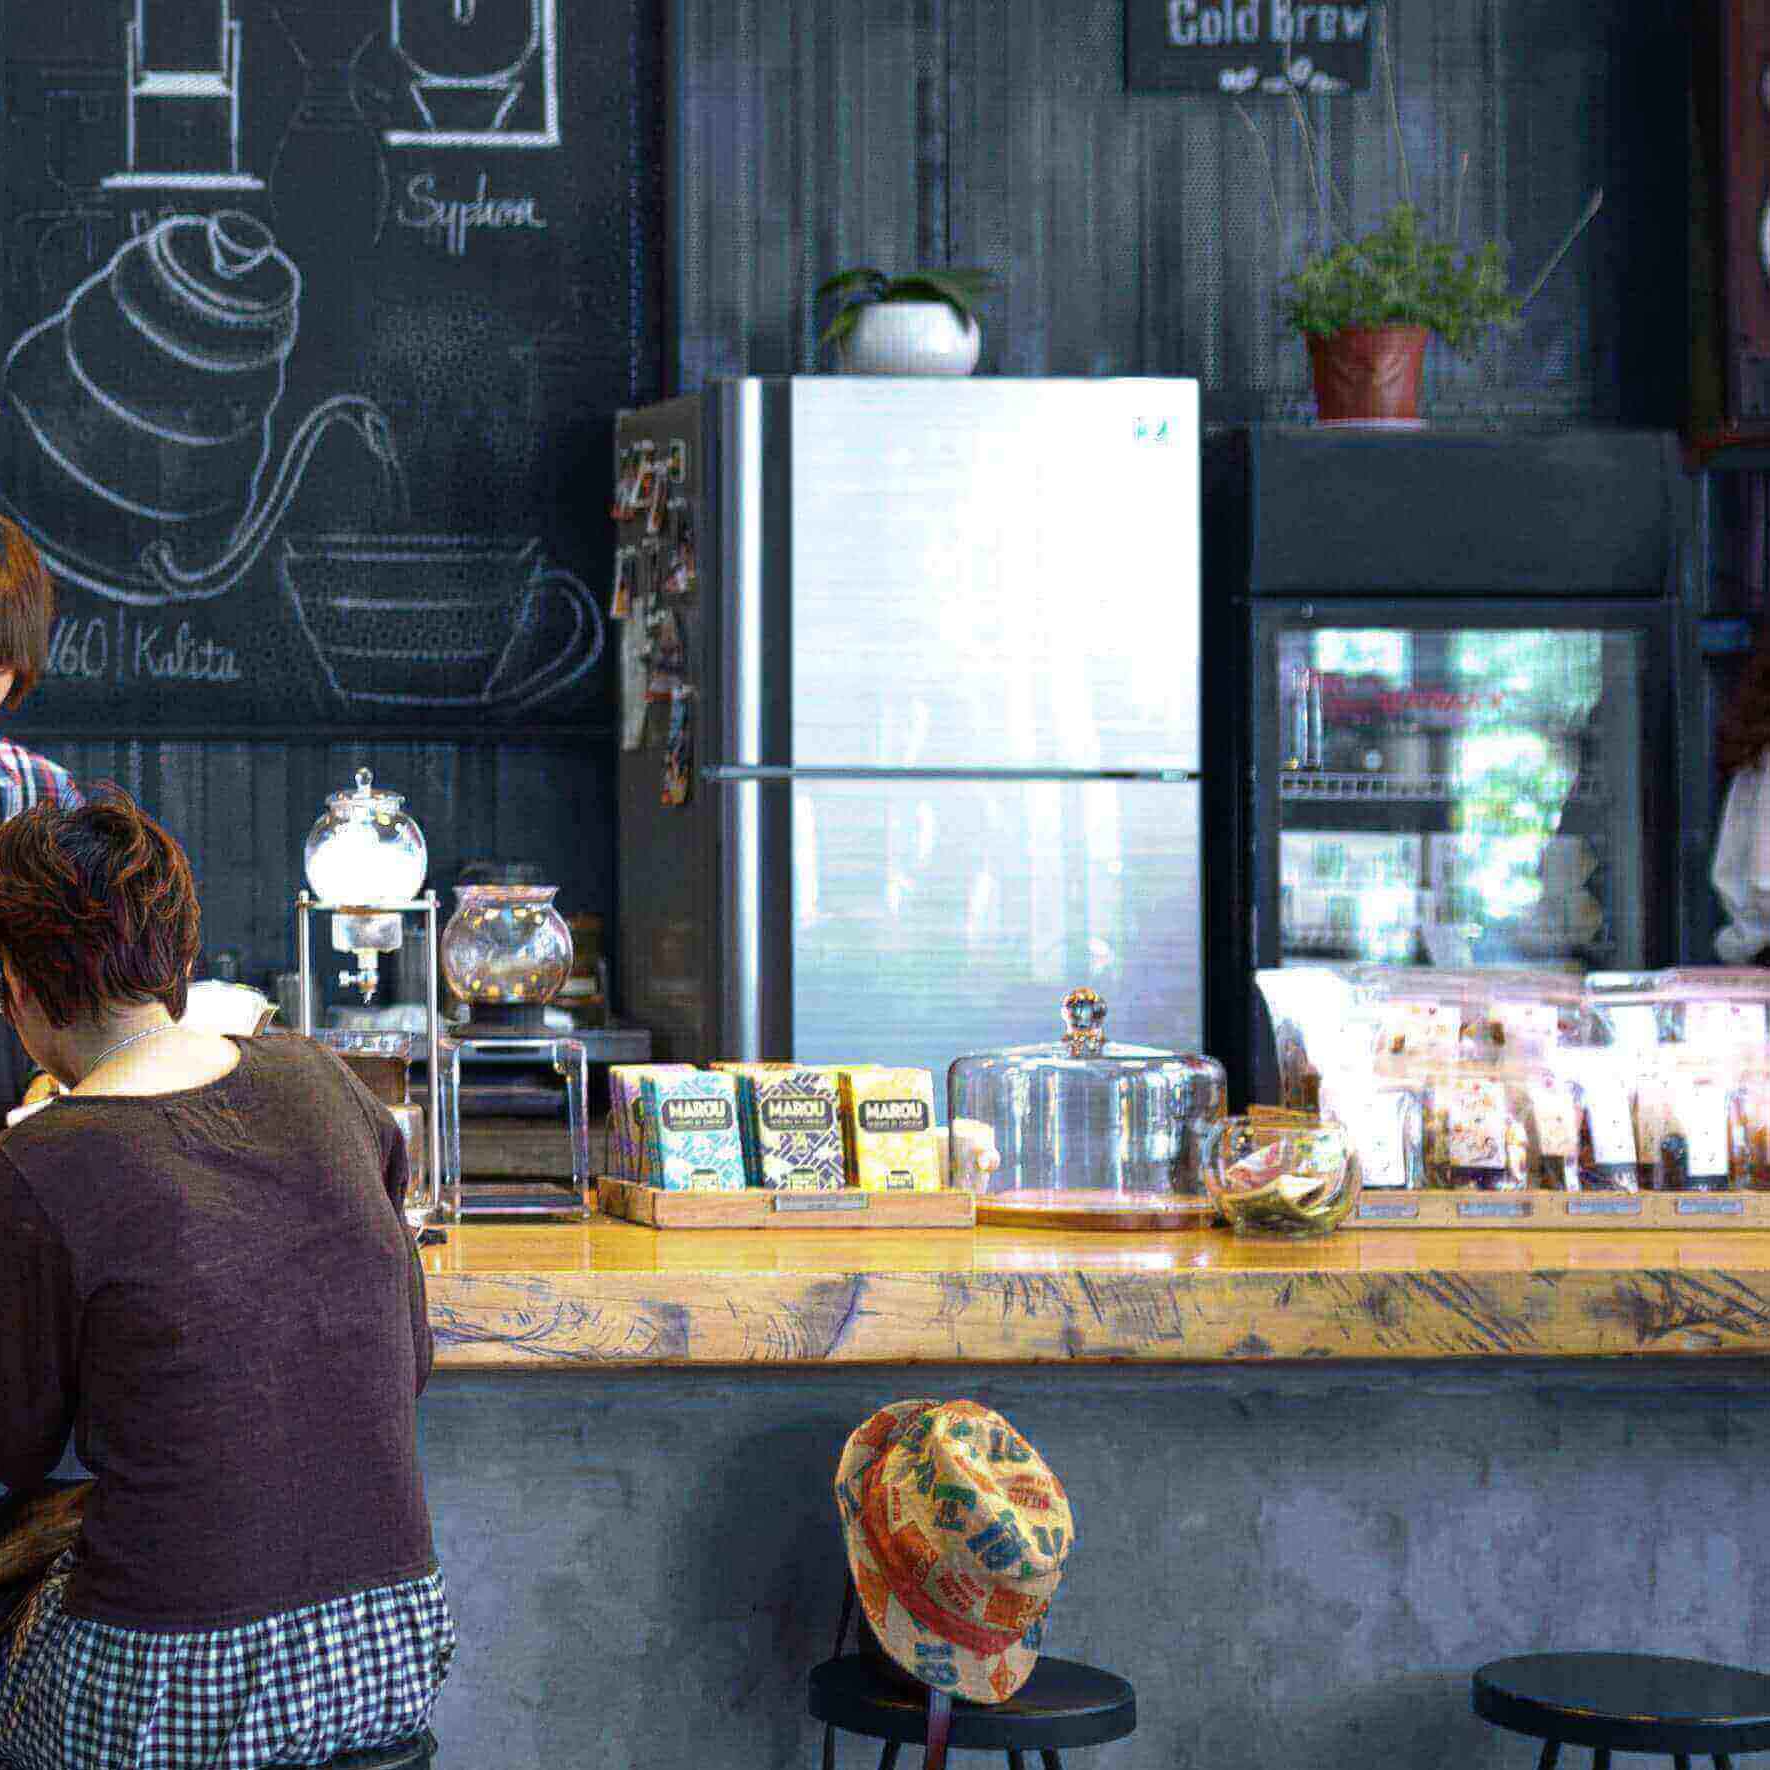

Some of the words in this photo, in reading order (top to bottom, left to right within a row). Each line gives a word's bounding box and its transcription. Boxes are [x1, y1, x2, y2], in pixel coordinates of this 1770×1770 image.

[1167, 0, 1259, 46] Cold
[667, 1100, 726, 1119] MAROU
[767, 1100, 826, 1119] MAROU
[864, 1102, 923, 1121] MAROU
